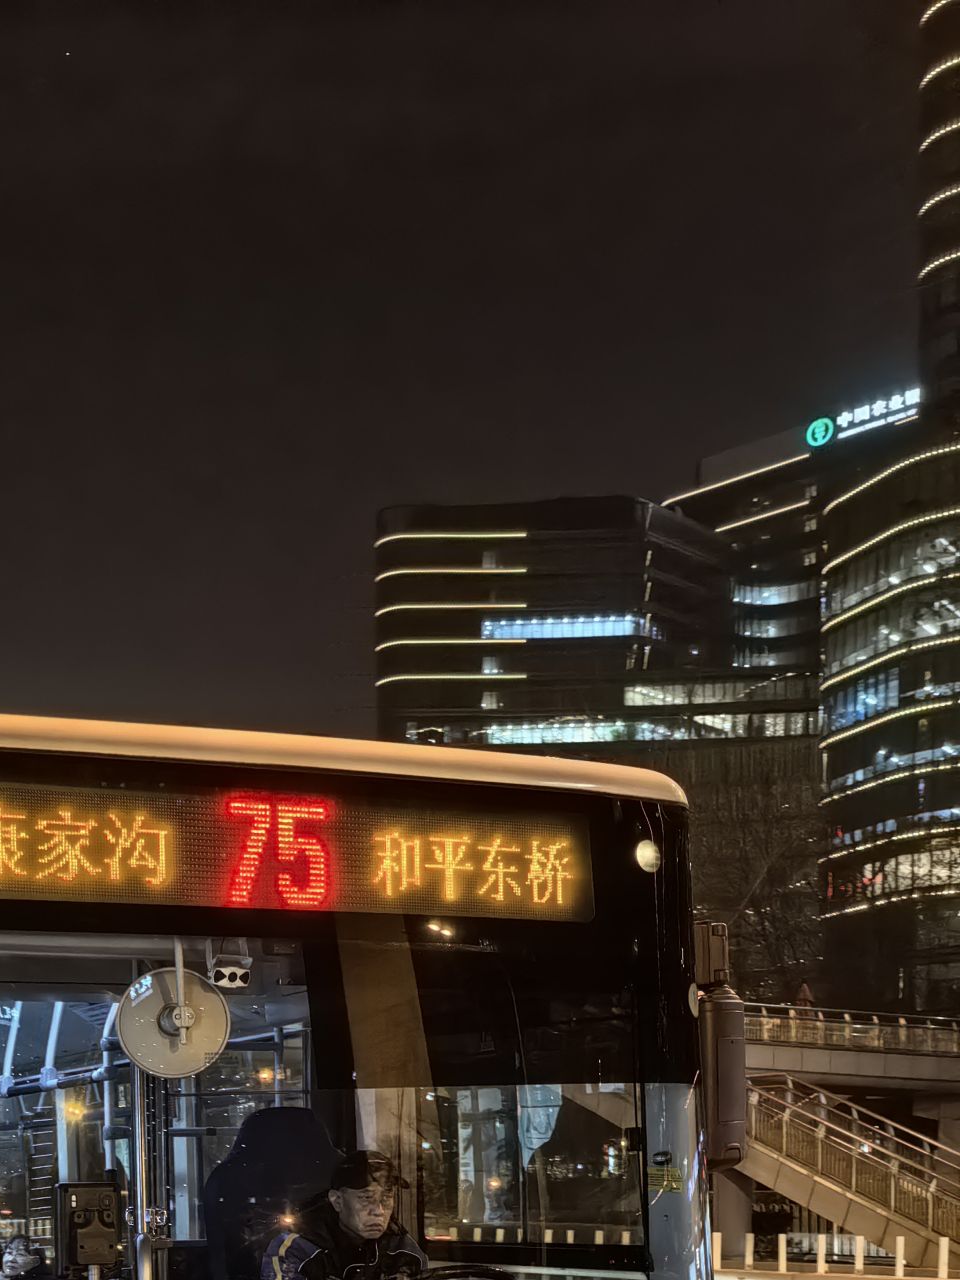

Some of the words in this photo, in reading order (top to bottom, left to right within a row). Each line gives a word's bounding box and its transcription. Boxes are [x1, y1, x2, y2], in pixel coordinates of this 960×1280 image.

[229, 801, 326, 905] 75
[372, 831, 574, 904] 和平东桥
